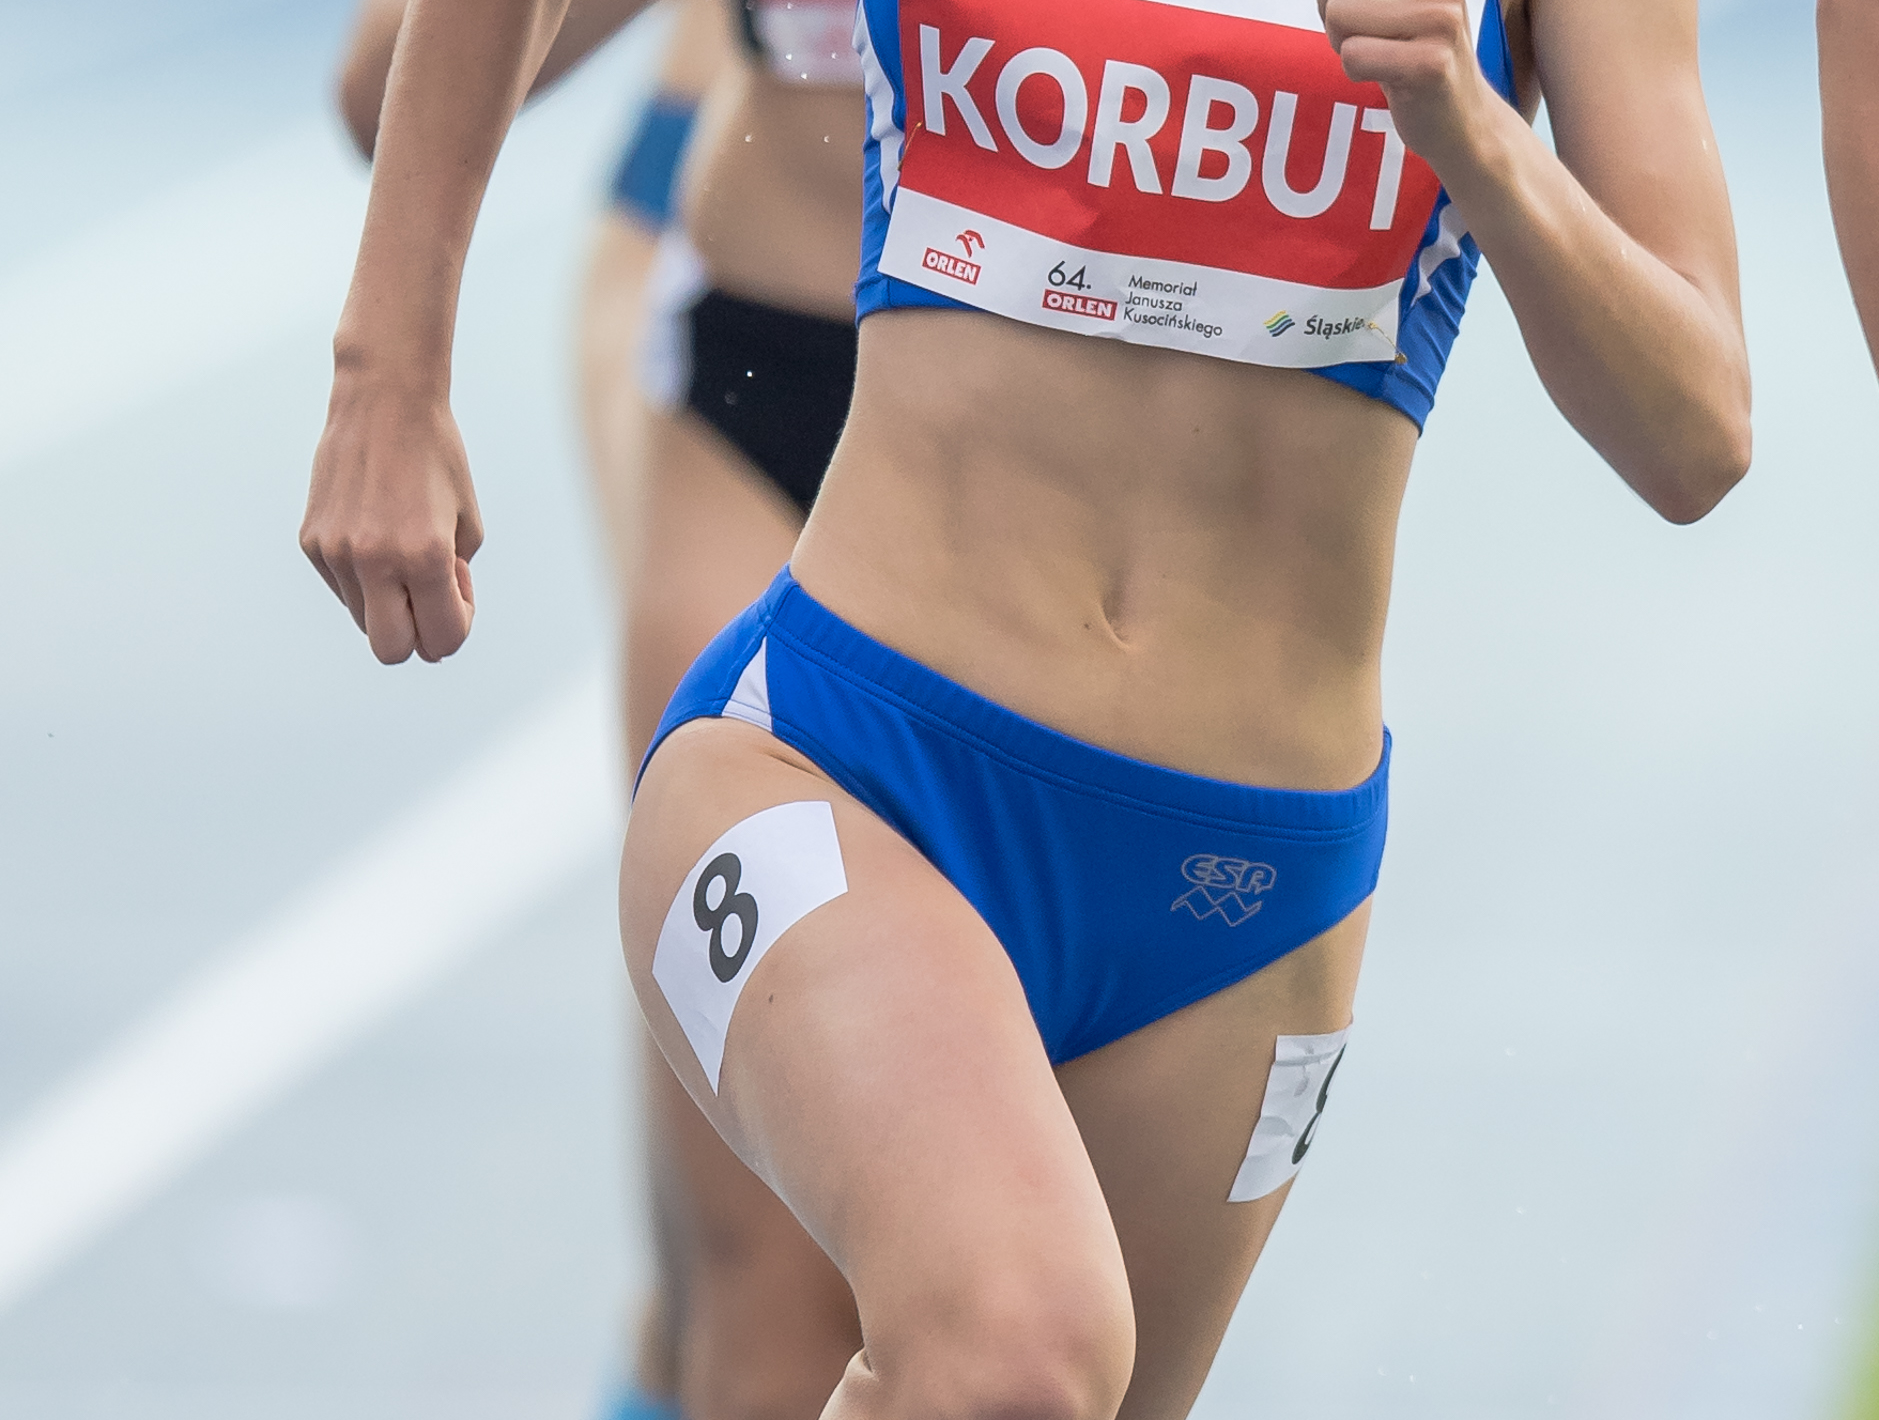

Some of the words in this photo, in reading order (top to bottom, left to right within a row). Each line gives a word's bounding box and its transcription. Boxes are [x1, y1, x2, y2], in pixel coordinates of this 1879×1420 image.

[919, 24, 1406, 231] KORBUT
[926, 251, 977, 282] ORLEN
[1047, 260, 1092, 291] 64.
[1125, 291, 1183, 312] Janusza
[1127, 275, 1198, 297] Memoriał
[1046, 293, 1113, 318] ORLEN
[1123, 307, 1223, 339] Kusocińskiego
[693, 852, 758, 983] 8
